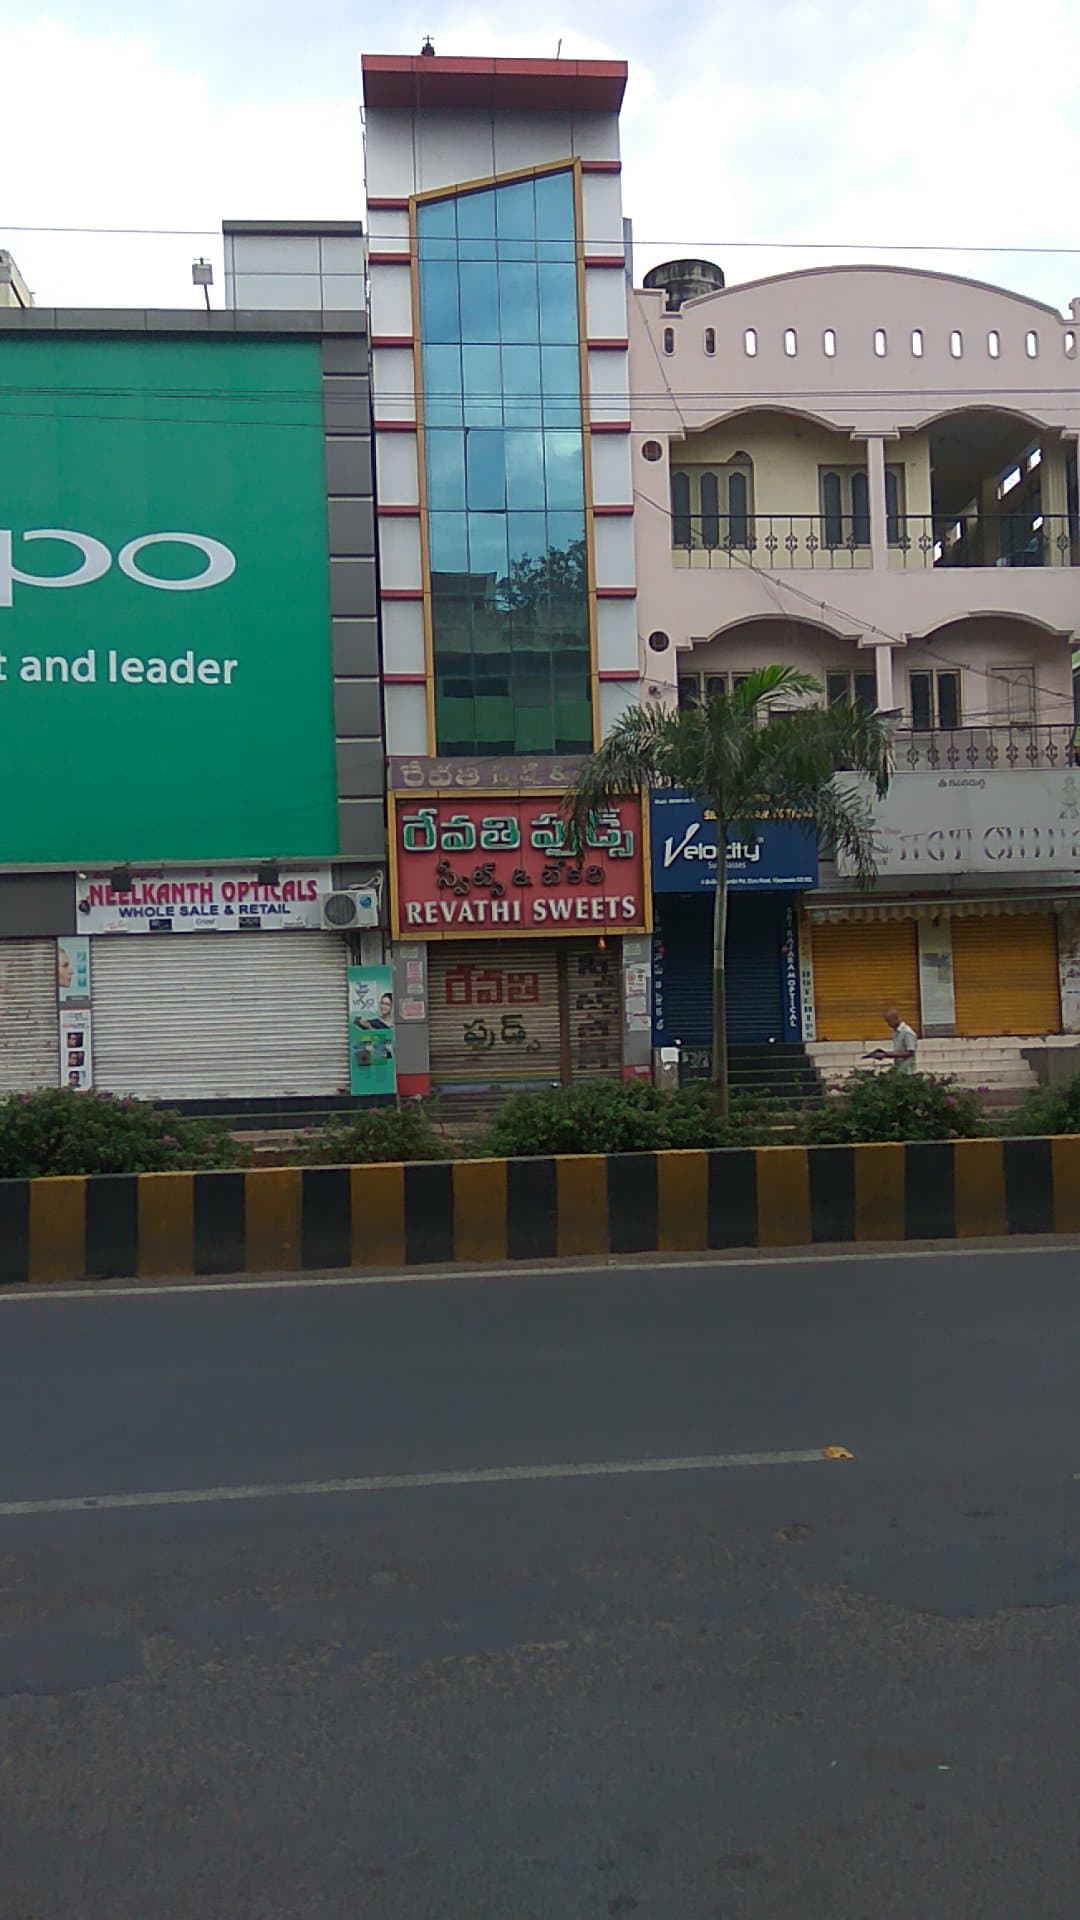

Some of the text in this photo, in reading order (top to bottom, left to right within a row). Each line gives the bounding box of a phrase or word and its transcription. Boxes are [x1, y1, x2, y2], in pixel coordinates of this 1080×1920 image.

[20, 650, 96, 682] and
[108, 650, 238, 684] leader
[402, 808, 520, 852] రేవతి
[663, 823, 760, 868] Velocity
[88, 879, 318, 907] NEELKANTH OPTICALS
[118, 902, 291, 918] WHOLE SALE & RETAIL
[406, 896, 636, 924] REVATHI SWEETS
[787, 980, 798, 1027] OPTICAL
